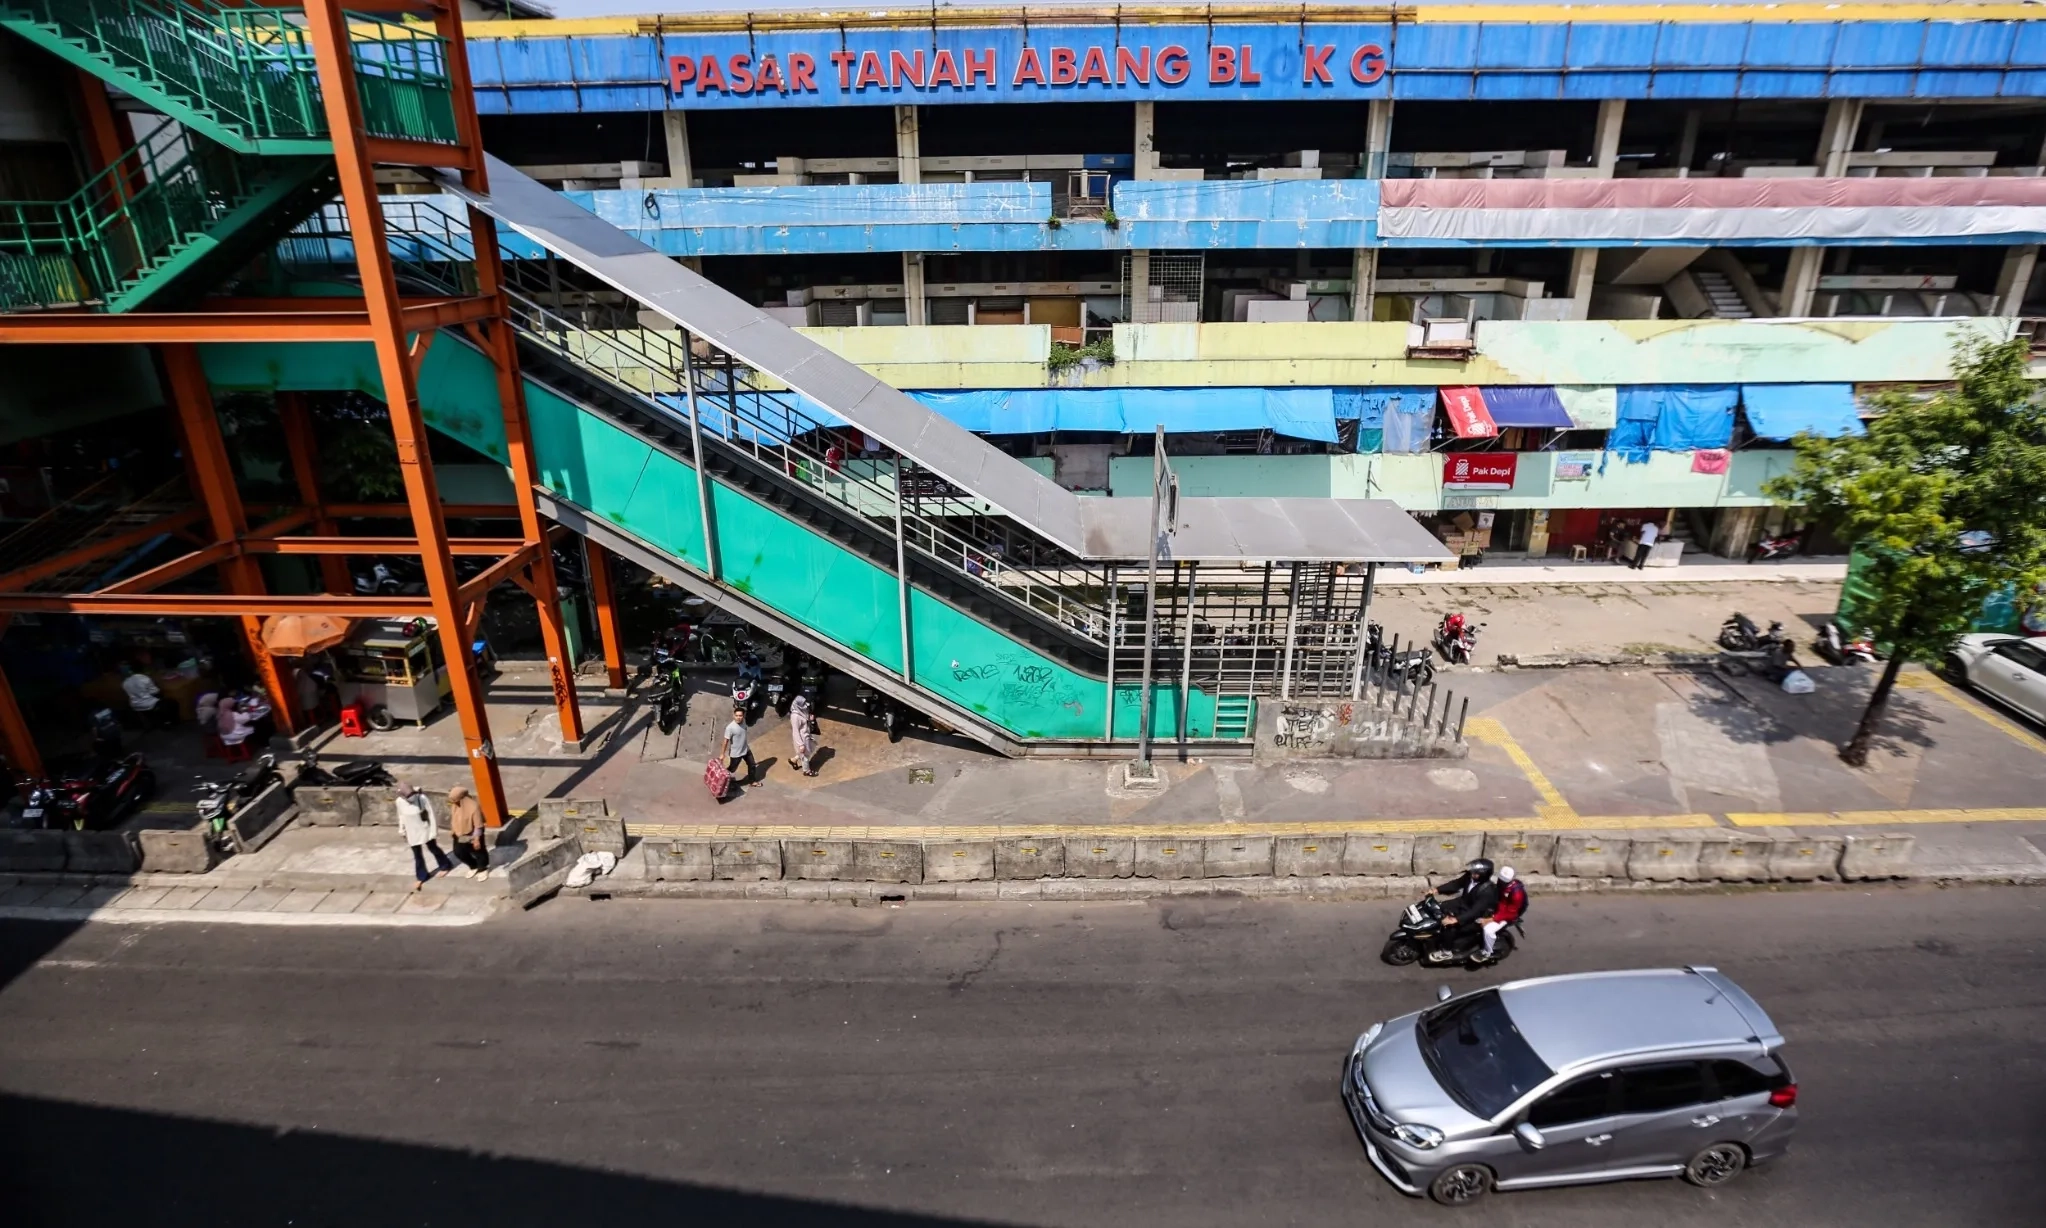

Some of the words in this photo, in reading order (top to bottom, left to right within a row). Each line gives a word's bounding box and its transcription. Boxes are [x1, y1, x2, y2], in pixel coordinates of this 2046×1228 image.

[667, 52, 818, 94] PASAR
[829, 48, 997, 89] TANAH
[1011, 45, 1191, 86] ABANG
[1350, 43, 1388, 84] G
[1472, 467, 1489, 475] Pak
[1490, 467, 1511, 477] Depi
